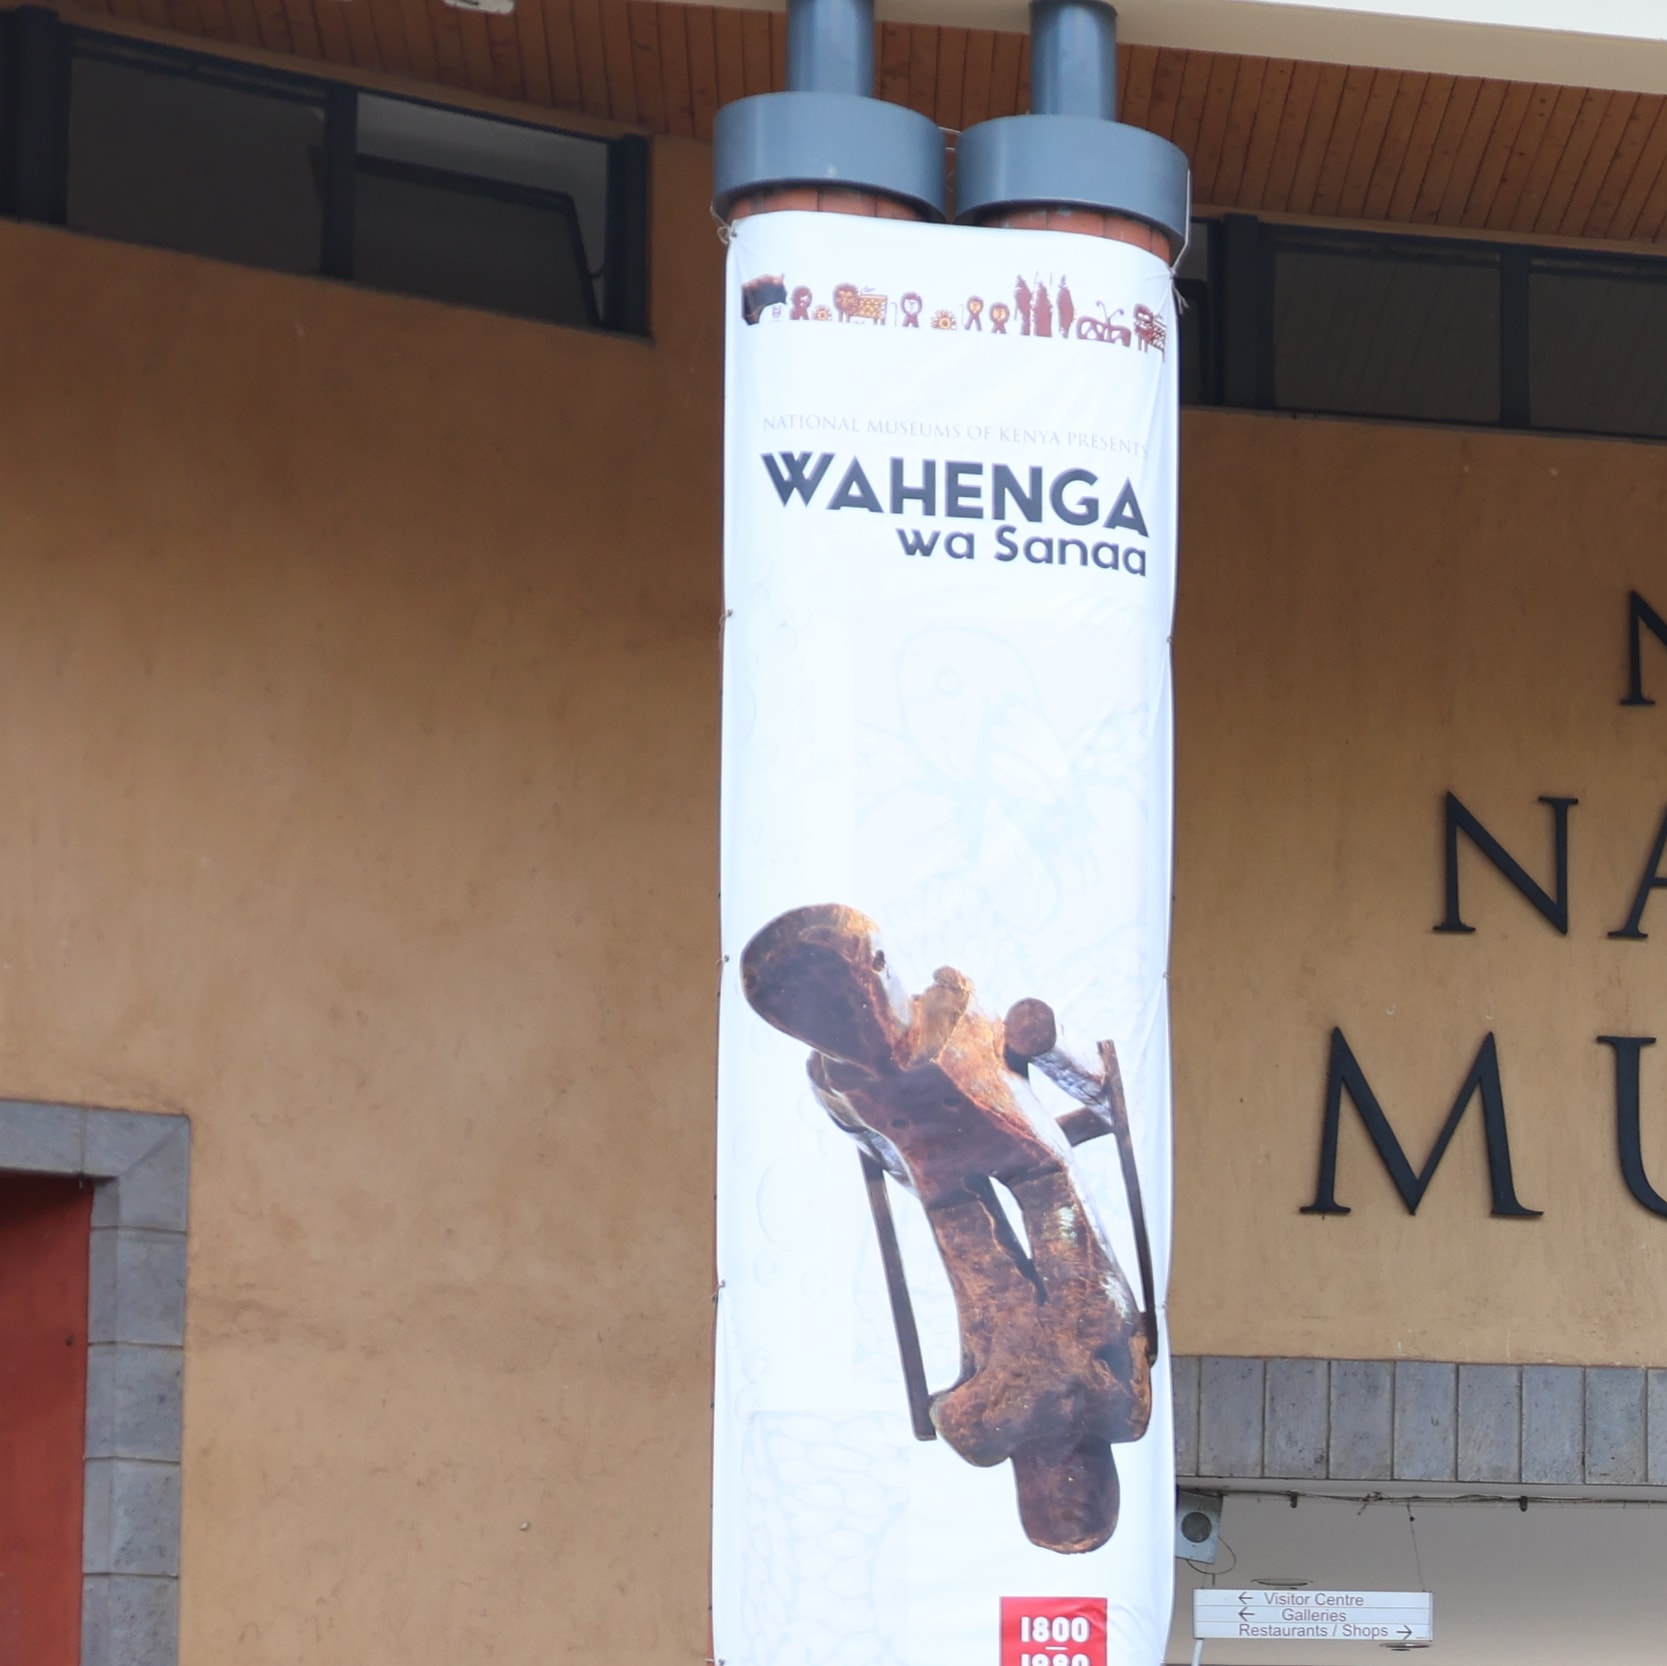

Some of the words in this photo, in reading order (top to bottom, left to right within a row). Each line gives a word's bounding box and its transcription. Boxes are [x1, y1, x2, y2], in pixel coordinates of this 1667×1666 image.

[763, 414, 861, 433] NATIONAL
[867, 418, 961, 440] MUSEUMS
[966, 422, 993, 443] OF
[998, 426, 1061, 447] KENYA
[1067, 430, 1150, 459] PRESENTS
[760, 450, 1150, 539] WAHENGA
[896, 528, 976, 559] wa
[993, 523, 1148, 578] Sanaa
[1264, 1592, 1310, 1606] Visitor
[1314, 1593, 1365, 1607] Centre
[1281, 1608, 1347, 1623] Galleries
[1020, 1616, 1090, 1643] 1800
[1238, 1623, 1328, 1638] Restaurants
[1342, 1624, 1389, 1640] Shops
